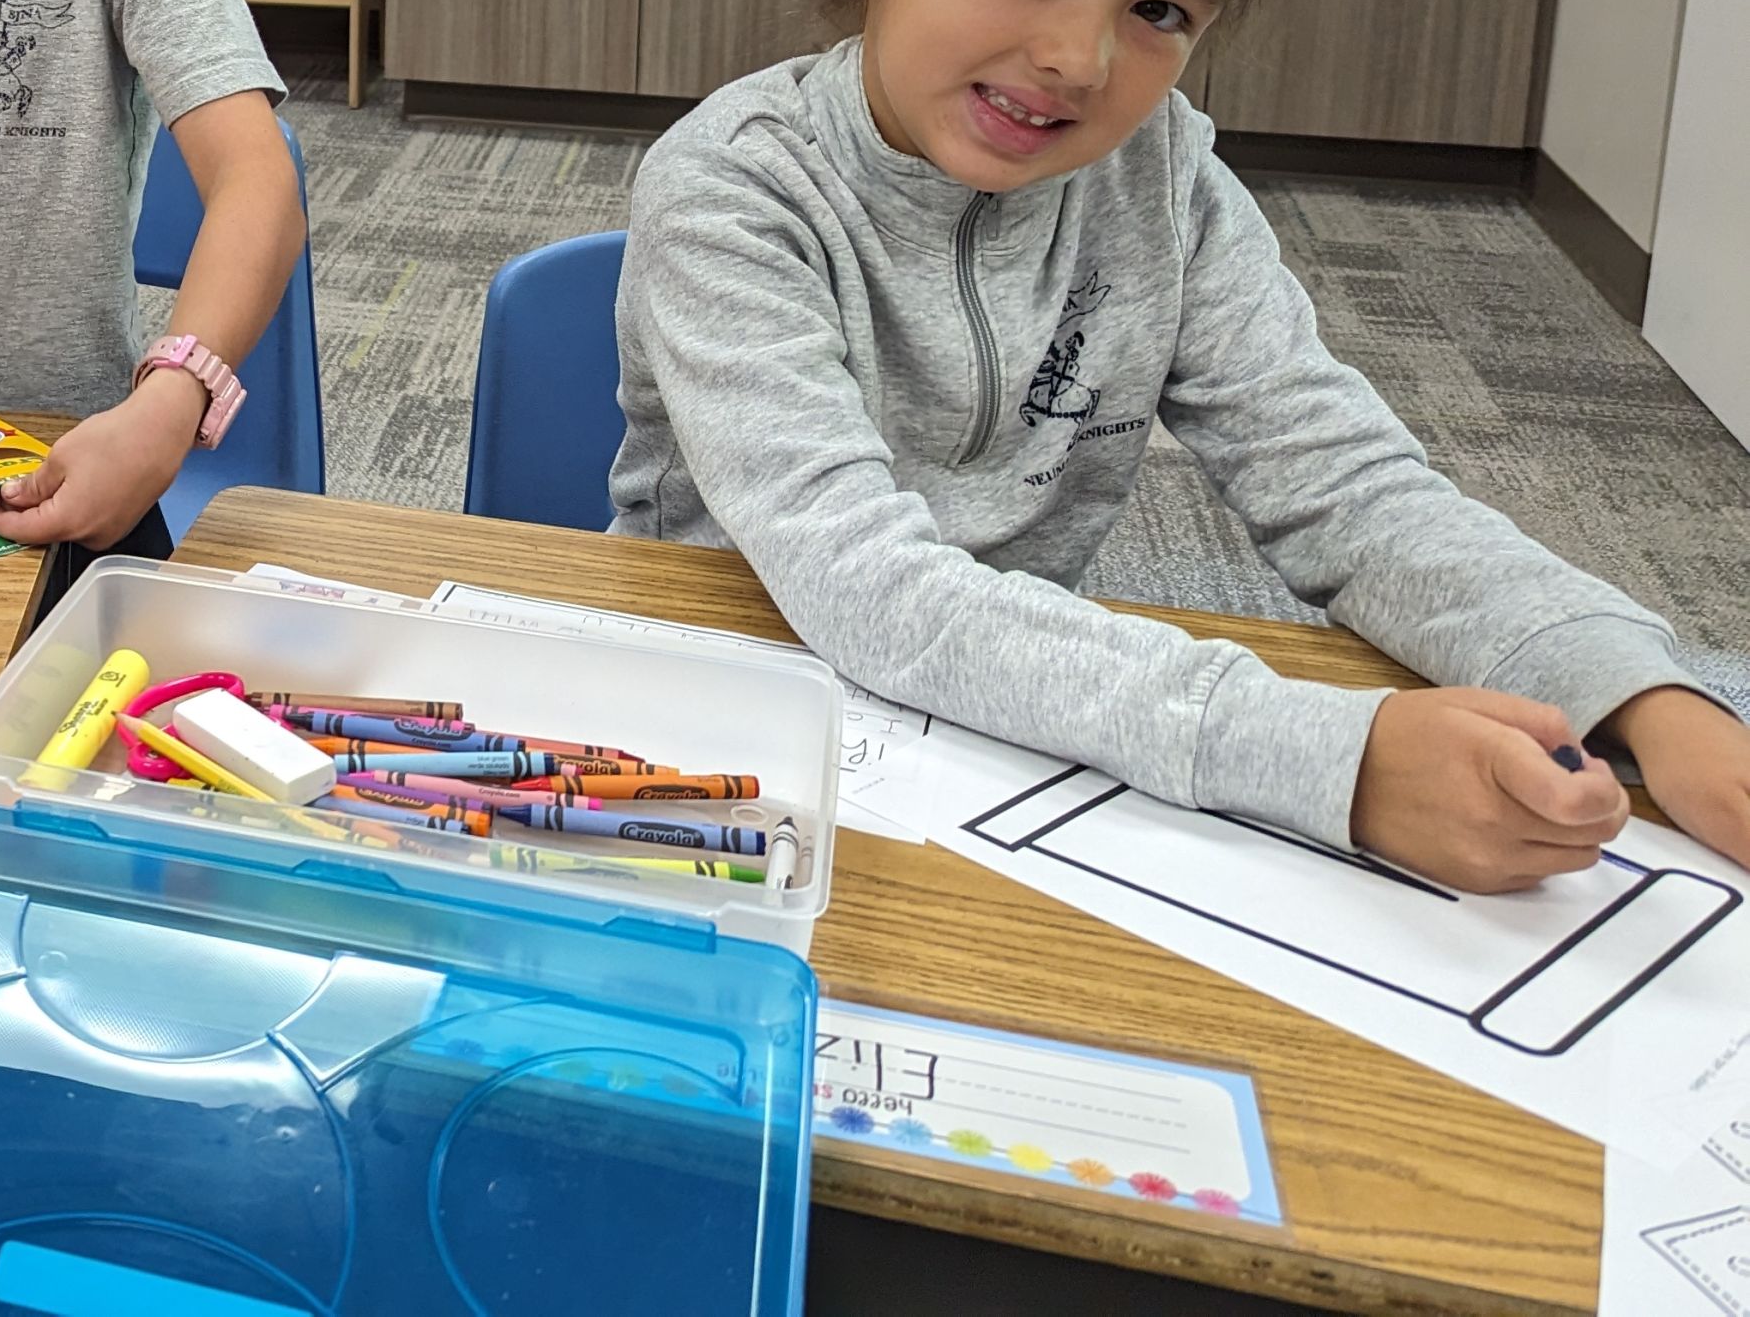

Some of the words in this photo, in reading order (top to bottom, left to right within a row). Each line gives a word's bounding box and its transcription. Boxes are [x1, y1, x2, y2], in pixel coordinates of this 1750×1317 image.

[4, 126, 67, 137] KNIGHTS
[621, 822, 701, 845] Crayola
[842, 1087, 913, 1117] hello
